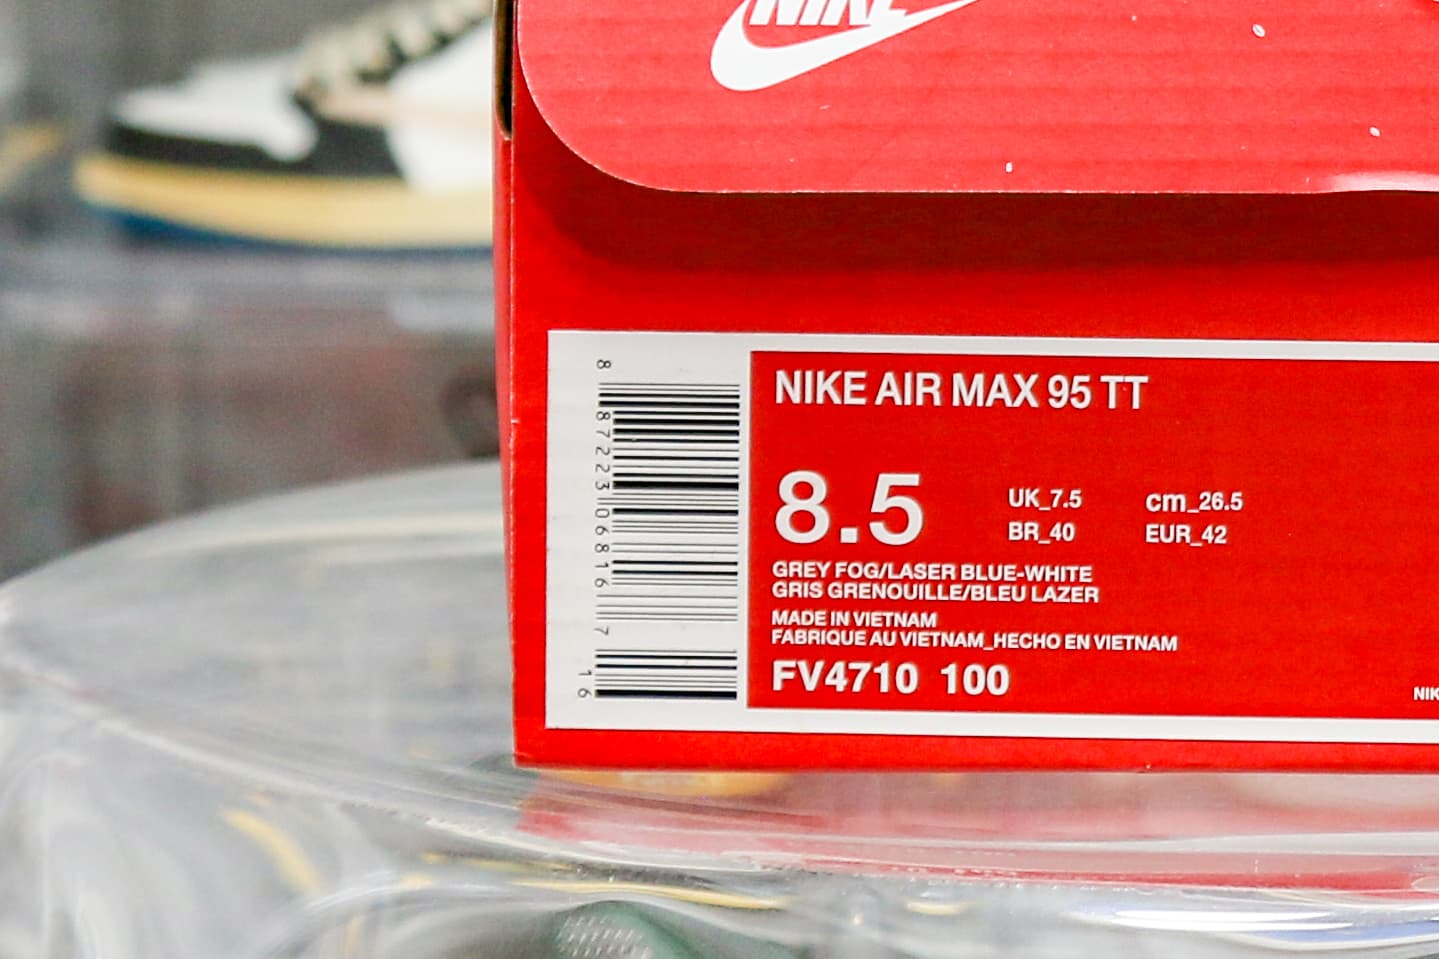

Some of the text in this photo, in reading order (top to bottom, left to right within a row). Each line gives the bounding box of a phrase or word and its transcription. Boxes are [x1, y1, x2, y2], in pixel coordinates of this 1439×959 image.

[776, 370, 1148, 409] NIKE AIR MAX 95 TT
[776, 471, 923, 545] 8.5
[1009, 488, 1082, 510] UK_7.5
[1146, 492, 1243, 513] cm_26.5
[1009, 522, 1075, 544] BR_40
[1146, 524, 1227, 546] EUR_42
[773, 561, 1092, 582] GREY FOG/LASER BLUE-WHITE
[773, 581, 1099, 603] GRIS GRENOUILLE/BLEU LAZER
[772, 610, 937, 627] MADE IN VIETNAM
[772, 629, 1177, 651] FABRIQUE AU VIETNAM_HECHO EN VIETNAM
[773, 660, 1009, 695] FV4710 100
